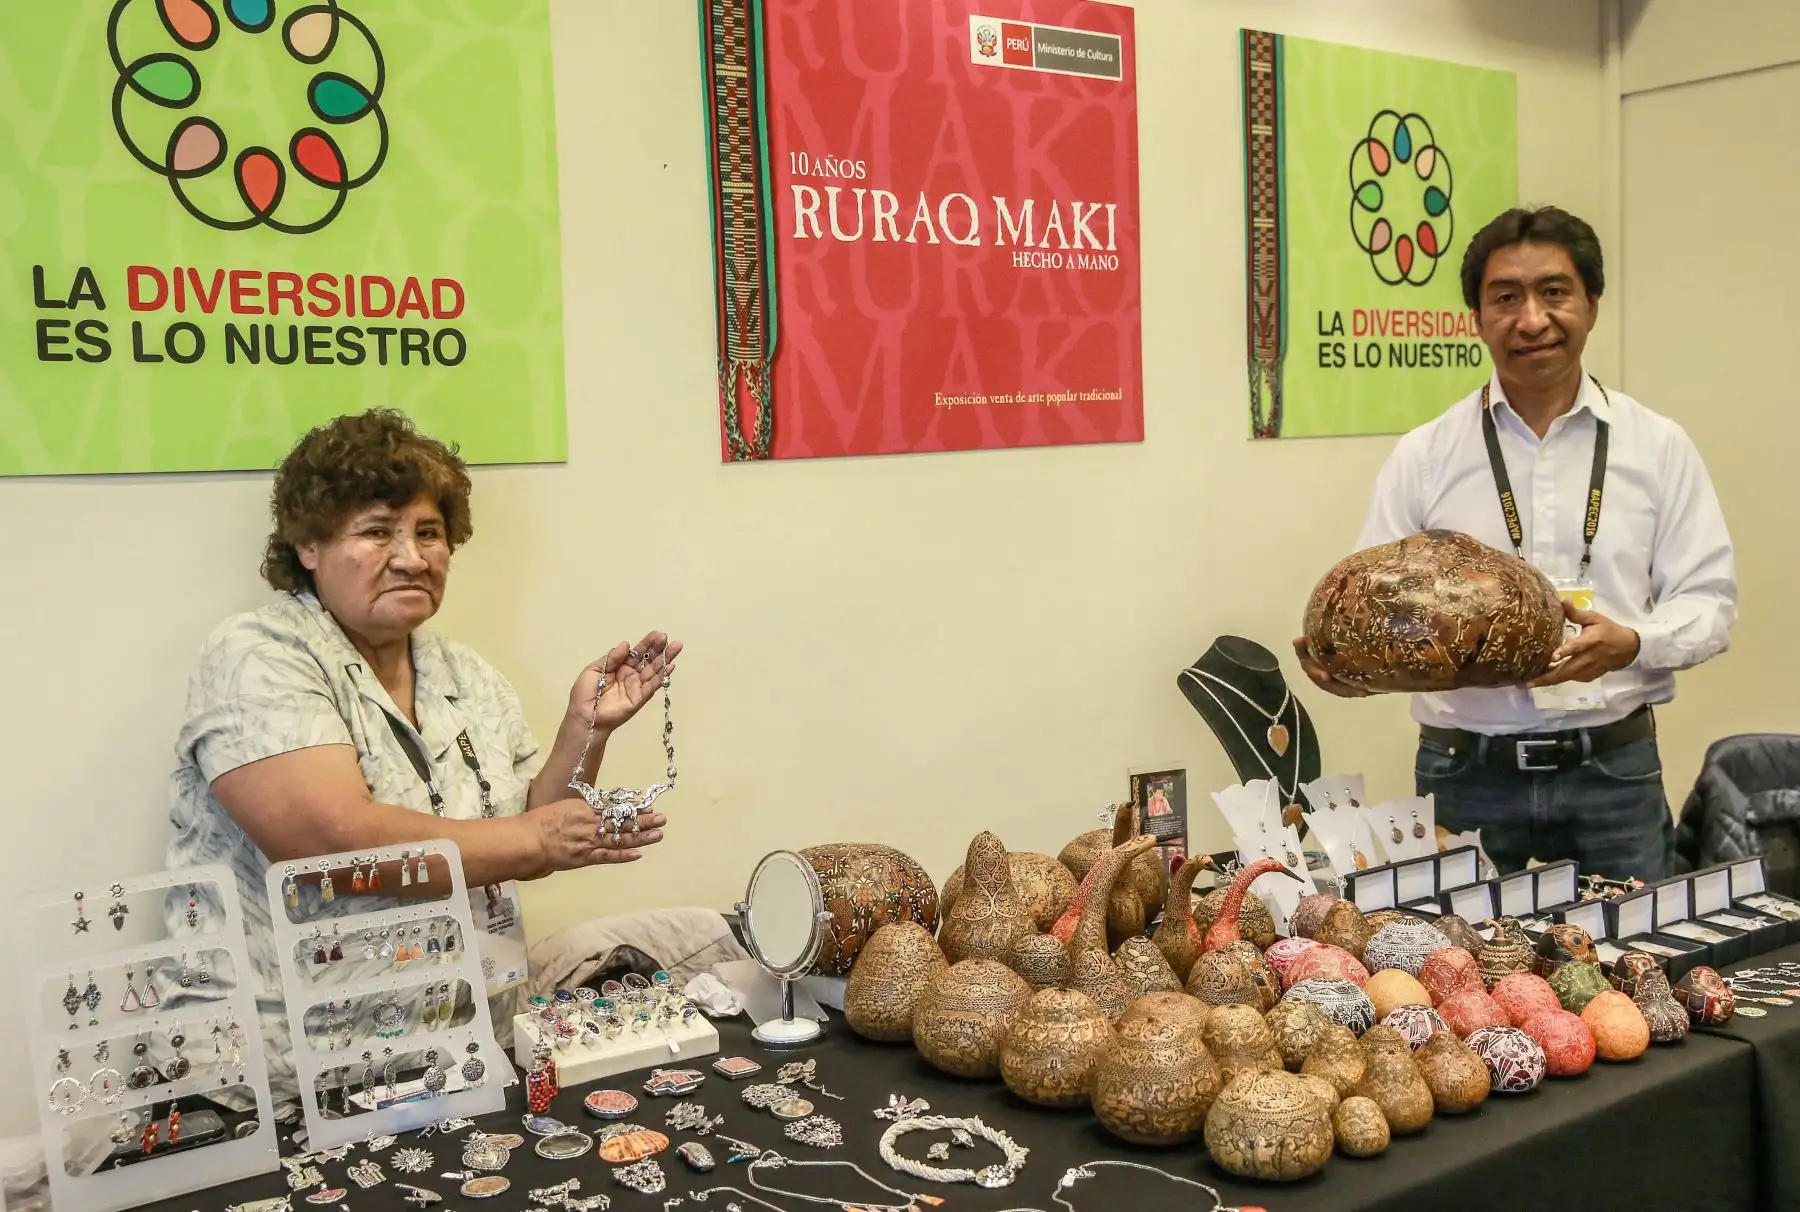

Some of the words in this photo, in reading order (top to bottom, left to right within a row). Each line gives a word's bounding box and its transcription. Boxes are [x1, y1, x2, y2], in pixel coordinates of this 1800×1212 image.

[1006, 37, 1029, 51] PERÚ
[1037, 43, 1075, 57] Ministerio
[1076, 47, 1086, 58] de
[1086, 50, 1113, 62] Cultura
[790, 151, 808, 176] 10
[812, 154, 866, 180] AÑOS
[790, 184, 980, 247] RURAQ
[992, 195, 1117, 251] MAKI
[1012, 252, 1062, 269] HECHO
[1065, 253, 1075, 269] A
[1077, 253, 1119, 271] MANO
[33, 265, 106, 310] LA
[127, 265, 466, 320] DIVERSIDAD
[1318, 310, 1344, 337] LA
[36, 319, 112, 362] ES
[132, 321, 206, 364] LO
[225, 323, 467, 367] NUESTRO
[1318, 342, 1345, 368] ES
[1354, 342, 1382, 368] LO
[1389, 342, 1482, 368] NUESTRO
[934, 392, 987, 410] Exposición
[990, 393, 1013, 404] venta
[1016, 391, 1026, 403] de
[1028, 392, 1045, 403] arte
[1046, 389, 1077, 406] popular
[1079, 388, 1122, 401] tradicional
[1500, 491, 1521, 539] #APEC2016
[1585, 488, 1601, 537] #APEC2016
[458, 732, 476, 758] #APE
